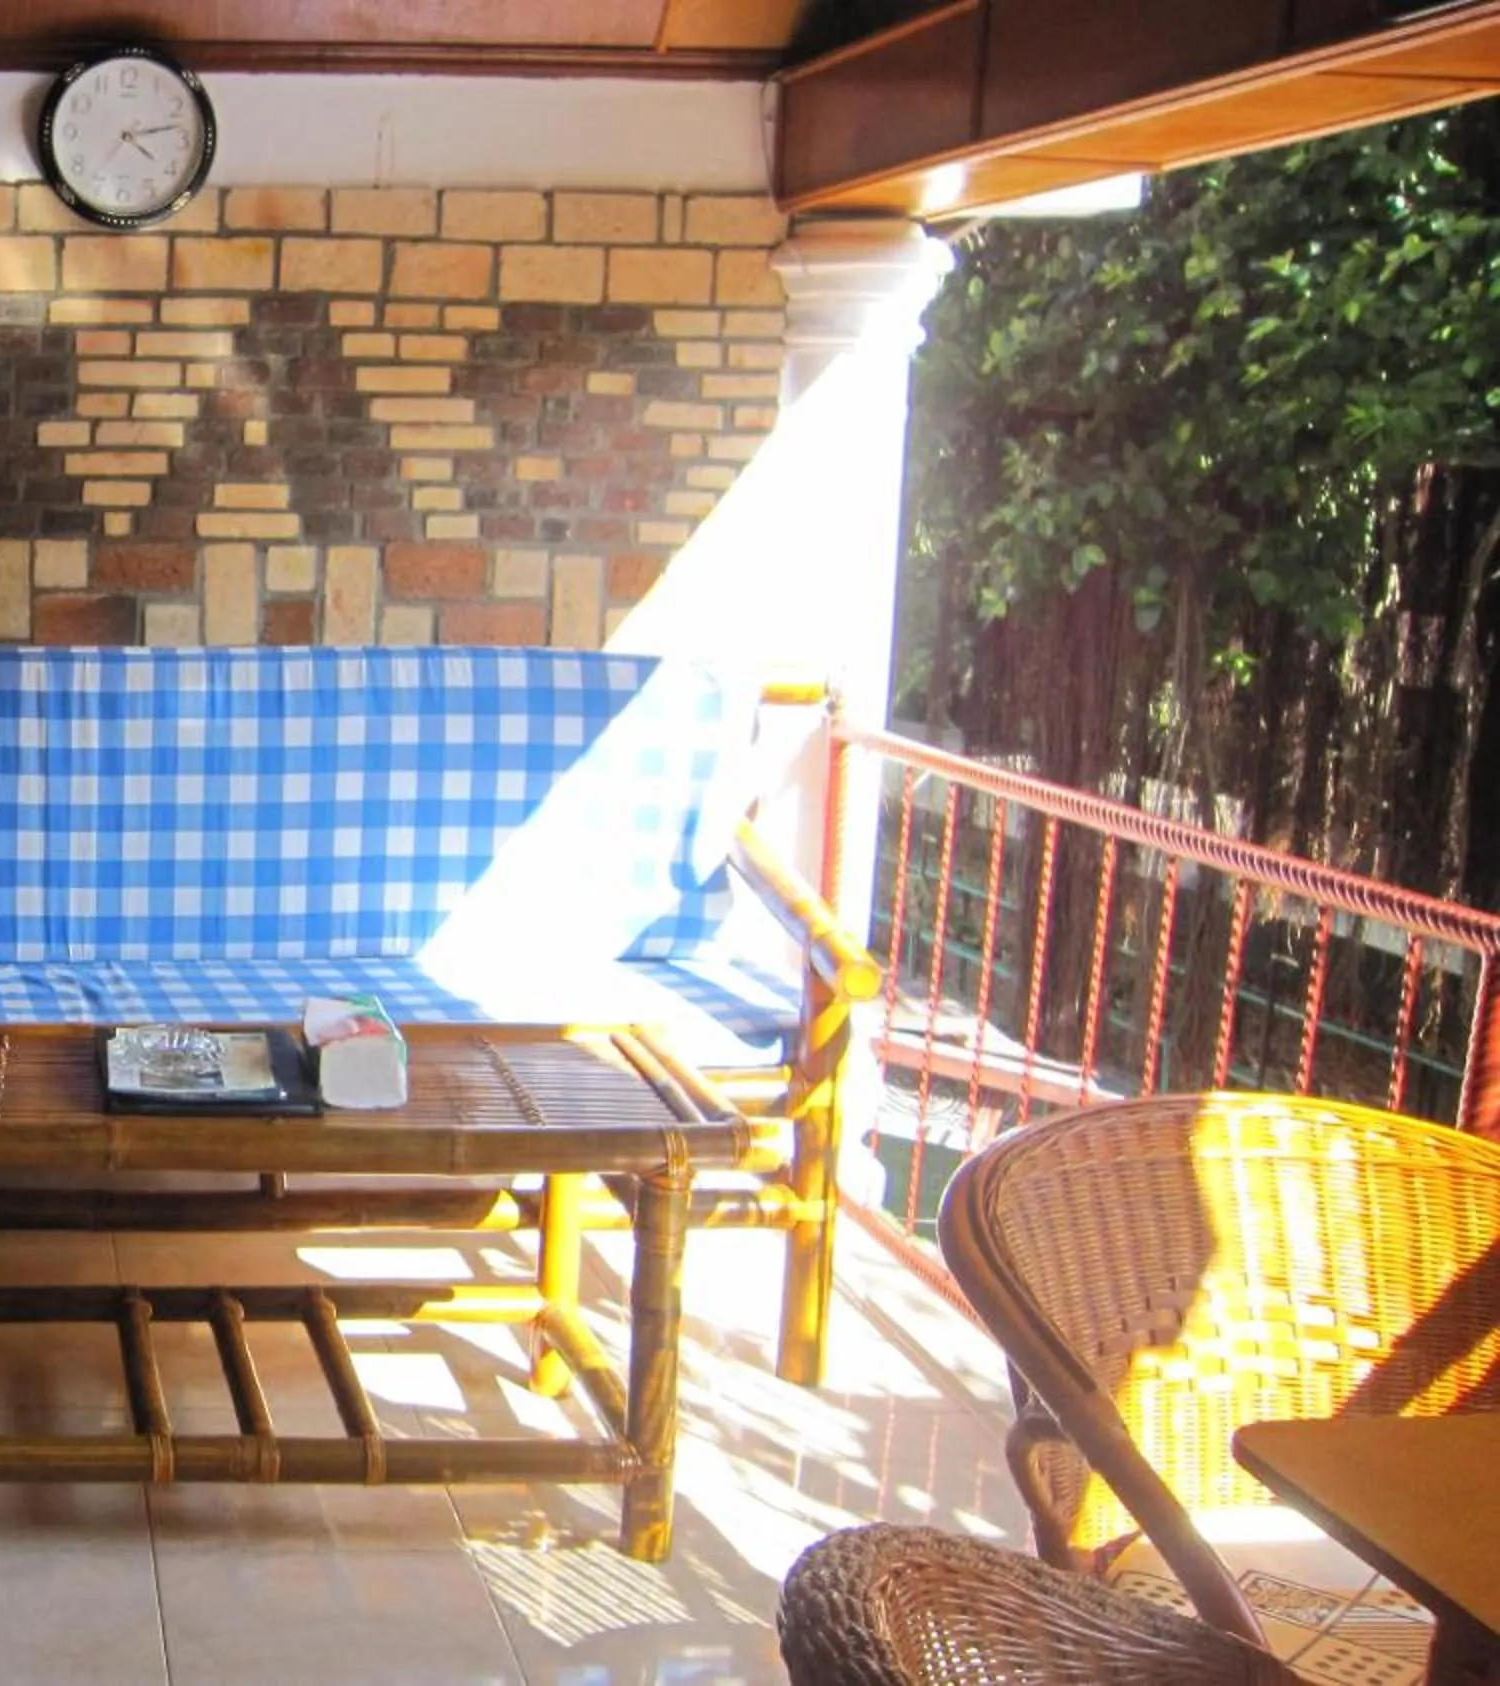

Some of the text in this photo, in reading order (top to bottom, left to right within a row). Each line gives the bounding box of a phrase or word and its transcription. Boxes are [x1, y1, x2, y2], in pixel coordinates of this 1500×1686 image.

[95, 75, 108, 95] 11
[120, 66, 138, 89] 12
[153, 76, 161, 94] 1
[71, 94, 92, 115] 10
[169, 97, 183, 118] 2
[63, 122, 78, 142] 9
[177, 128, 190, 150] 3
[71, 153, 86, 175] 8
[163, 159, 177, 176] 4
[92, 173, 106, 197] 7
[115, 180, 131, 203] 6
[143, 178, 157, 199] 5
